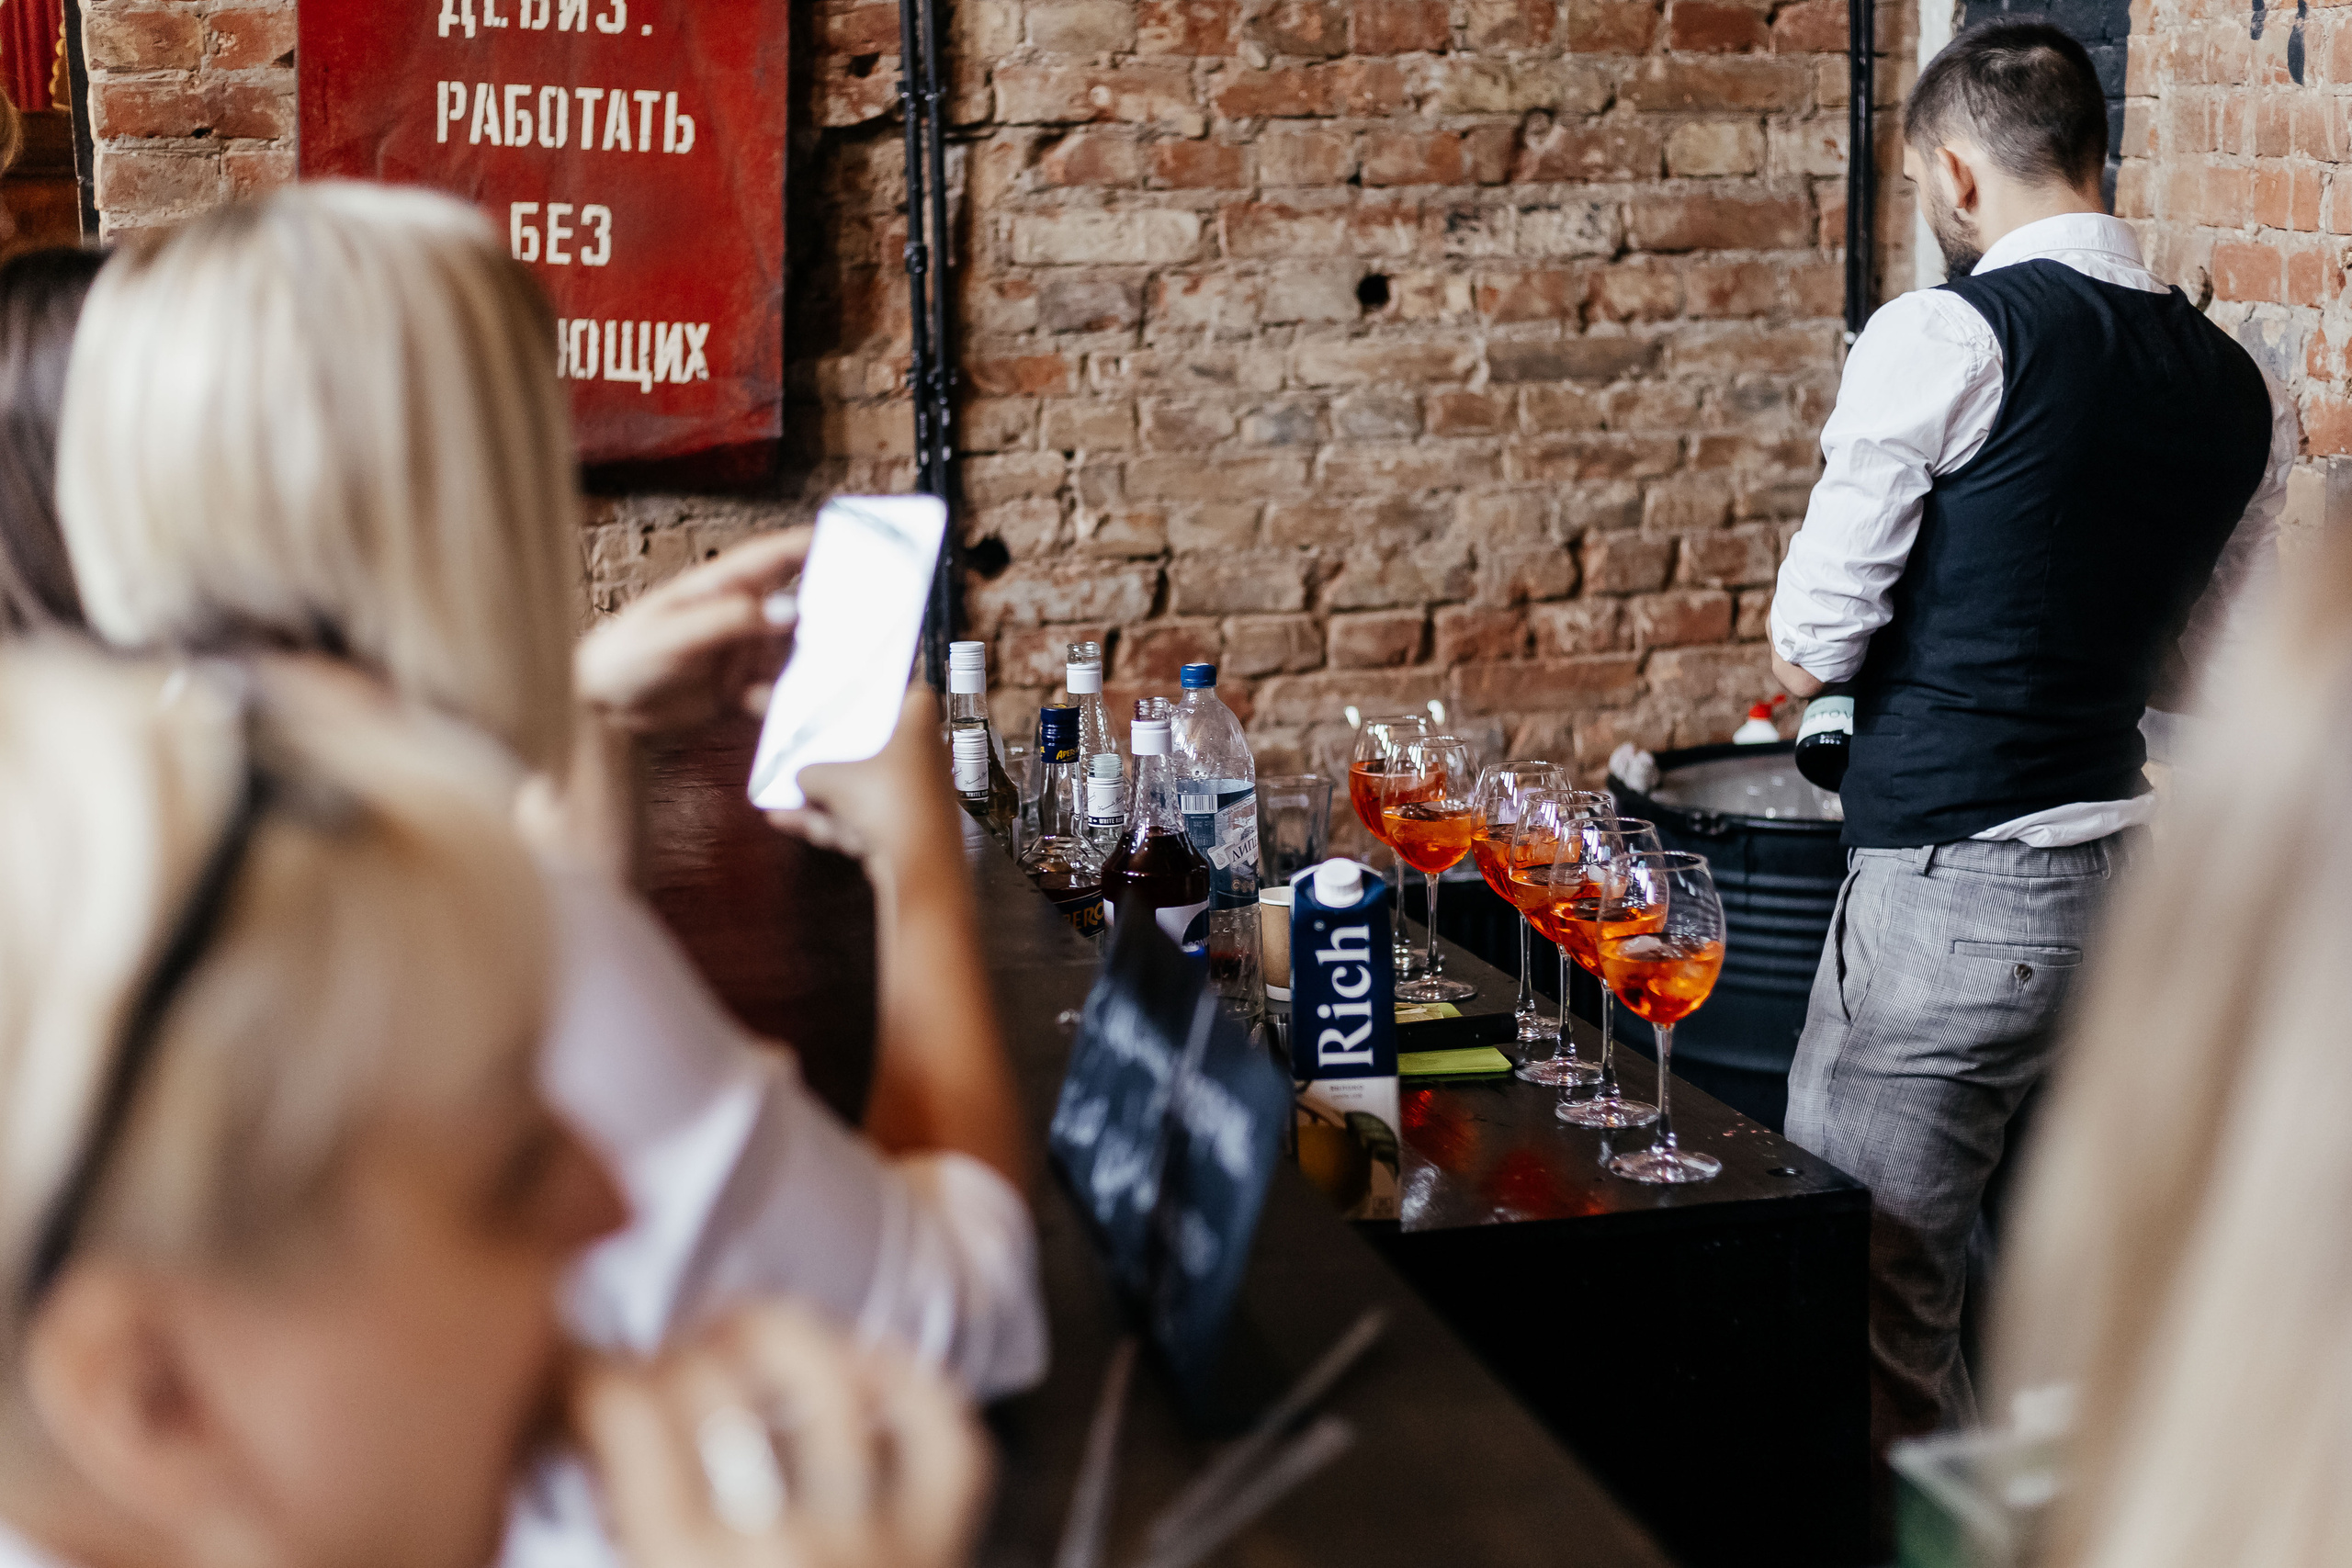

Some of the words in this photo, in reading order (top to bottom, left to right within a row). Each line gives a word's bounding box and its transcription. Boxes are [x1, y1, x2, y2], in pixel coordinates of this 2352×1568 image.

[436, 80, 695, 154] РАБОТАТЬ
[510, 201, 613, 266] БЕЗ
[1315, 924, 1374, 1068] Rich
